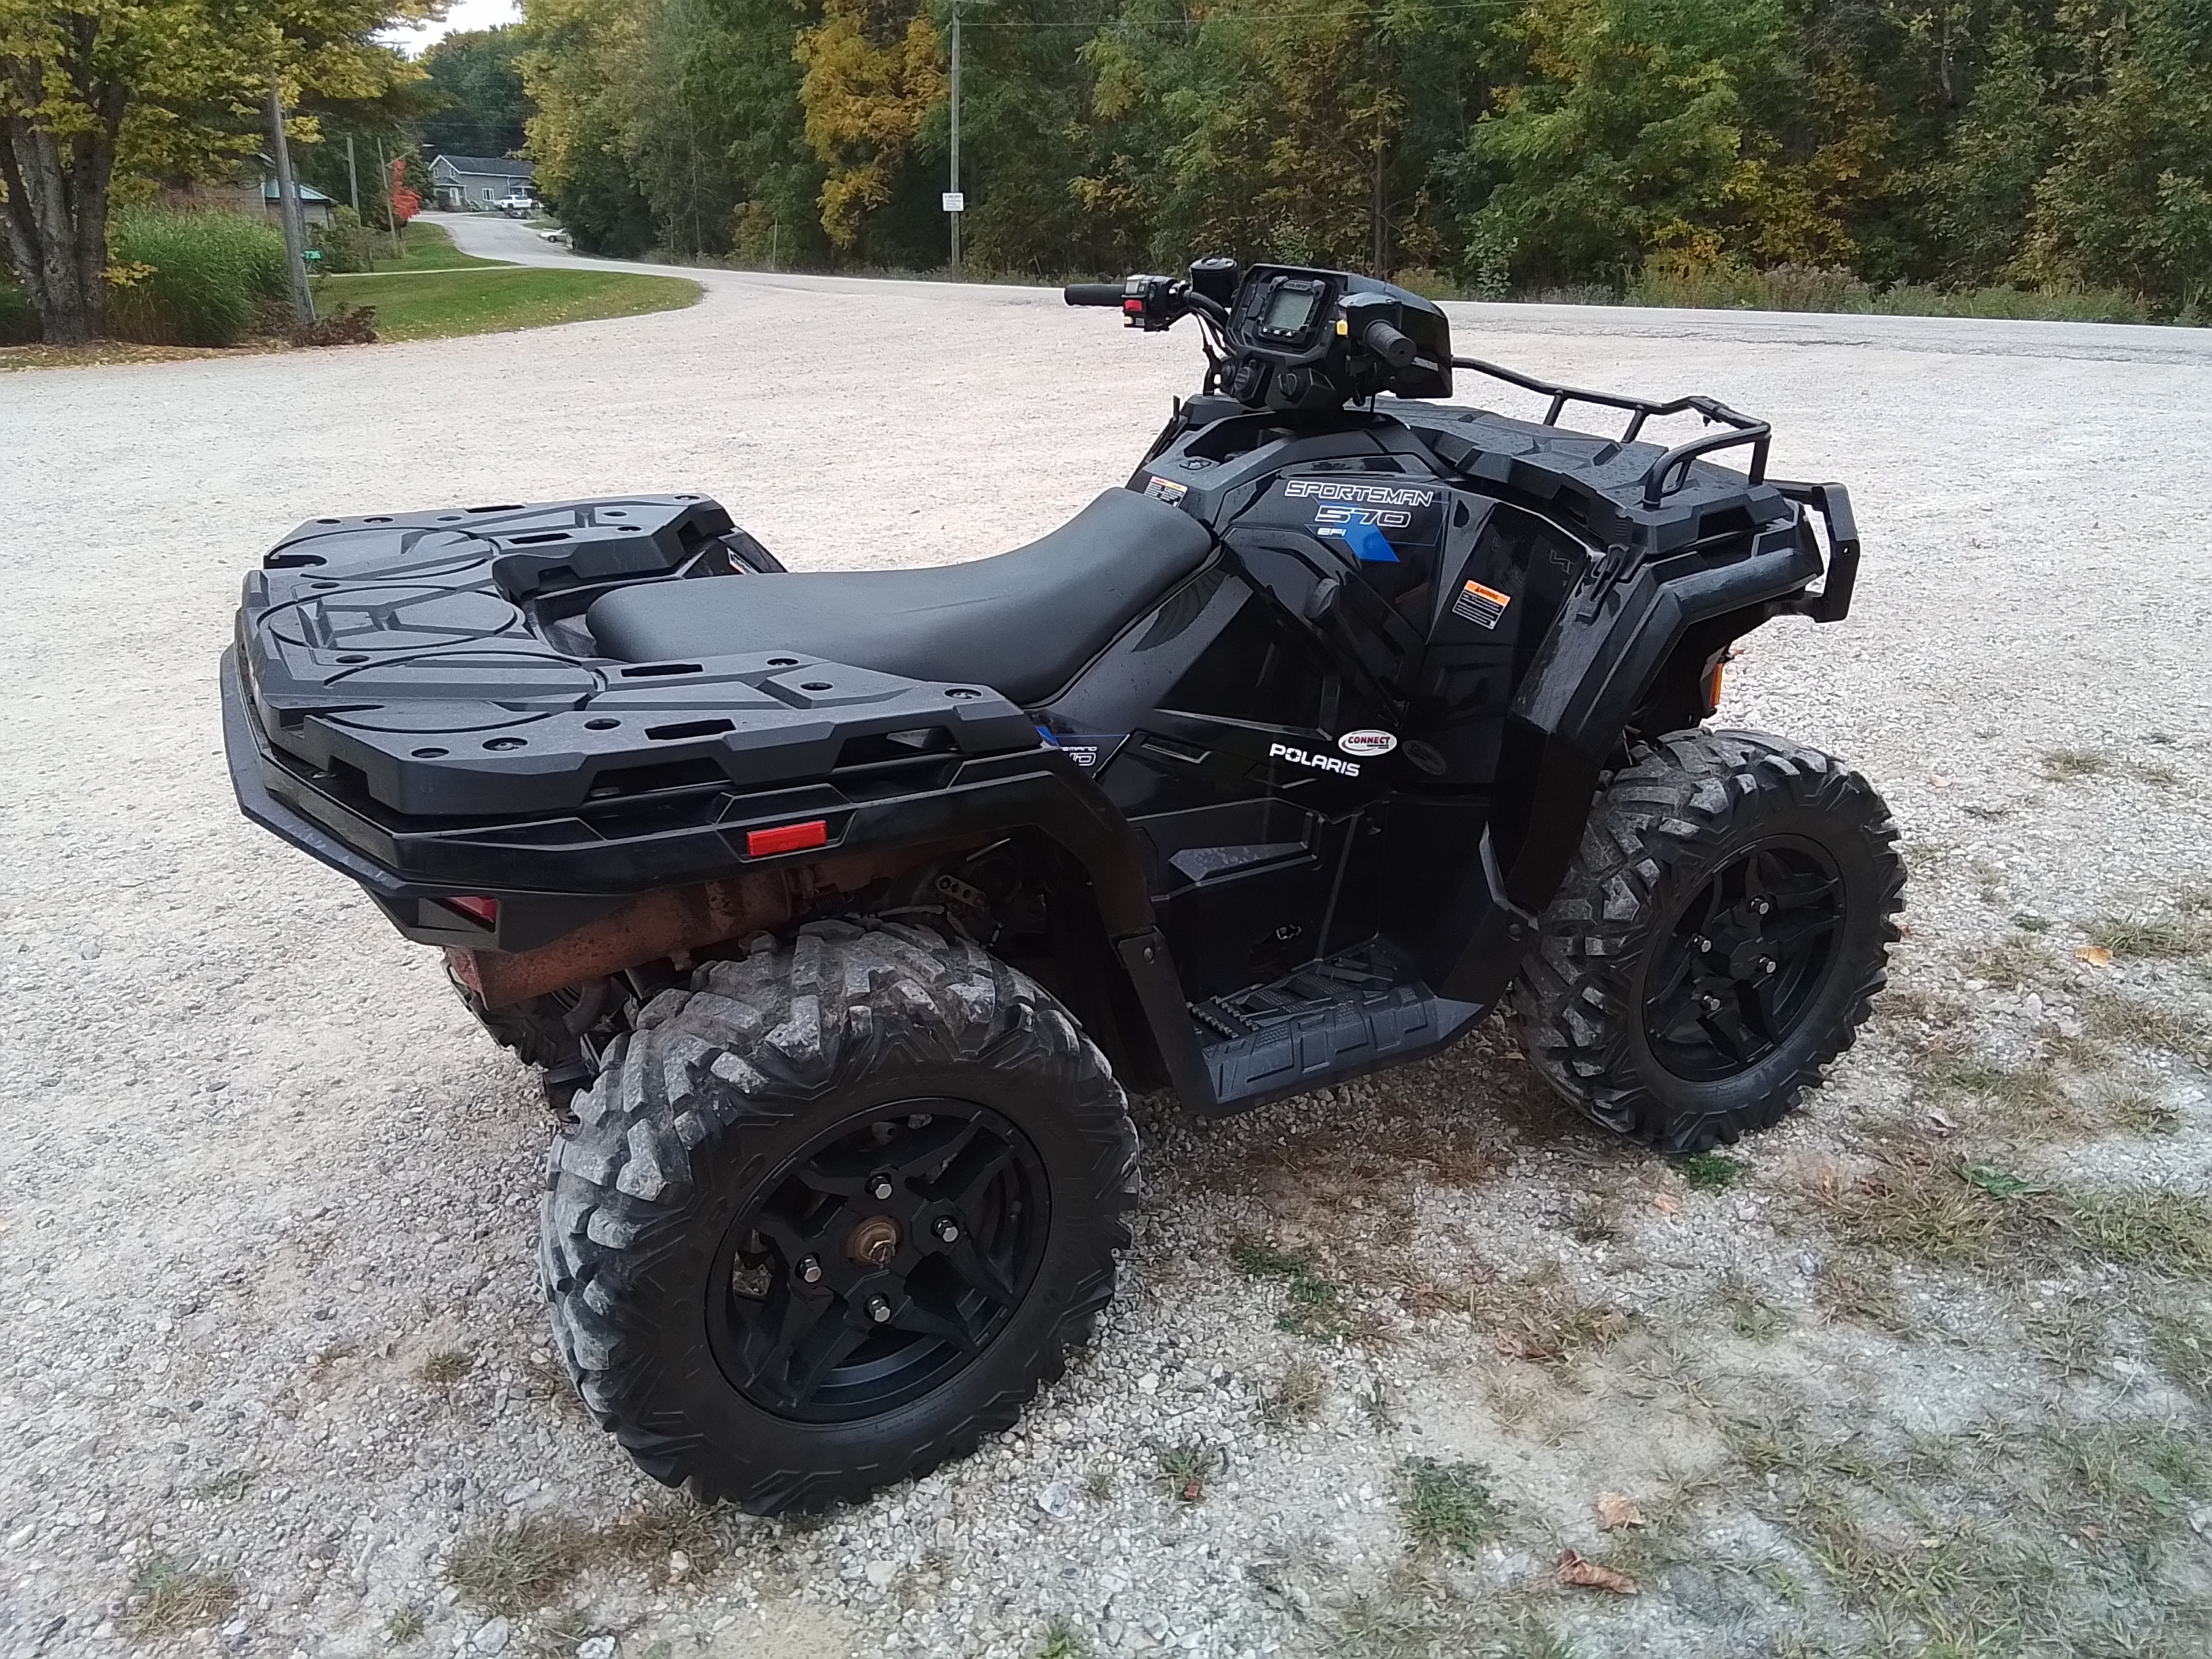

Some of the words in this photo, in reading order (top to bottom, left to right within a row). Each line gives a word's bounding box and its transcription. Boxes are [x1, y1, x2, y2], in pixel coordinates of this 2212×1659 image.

[304, 250, 321, 259] 736
[1284, 480, 1433, 507] SPORTSMAN
[1315, 505, 1411, 528] 570
[1317, 527, 1347, 536] EFI
[1348, 736, 1391, 744] CONNECT
[1269, 743, 1361, 777] POLARIS
